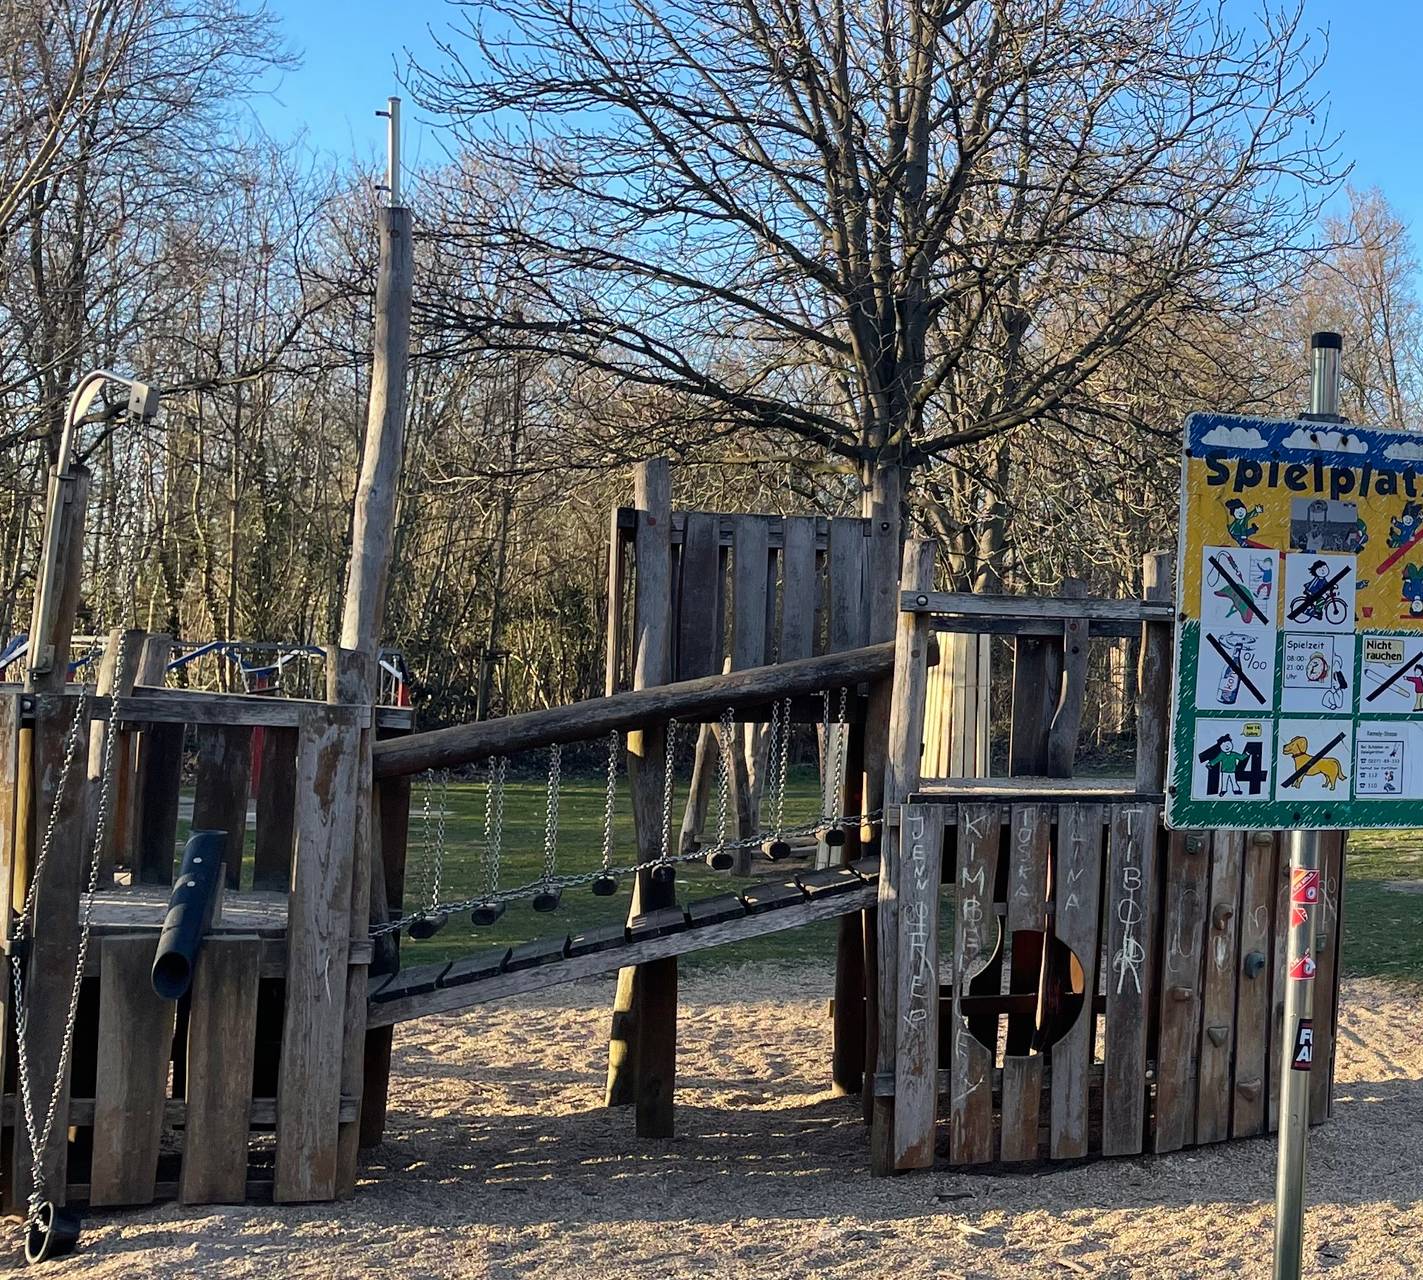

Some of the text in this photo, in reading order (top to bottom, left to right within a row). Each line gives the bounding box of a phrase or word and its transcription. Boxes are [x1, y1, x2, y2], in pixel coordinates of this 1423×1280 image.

[1286, 640, 1325, 651] Spielzeit
[1366, 640, 1392, 650] Nicht
[1366, 651, 1402, 661] rauchen
[1198, 741, 1268, 796] 14
